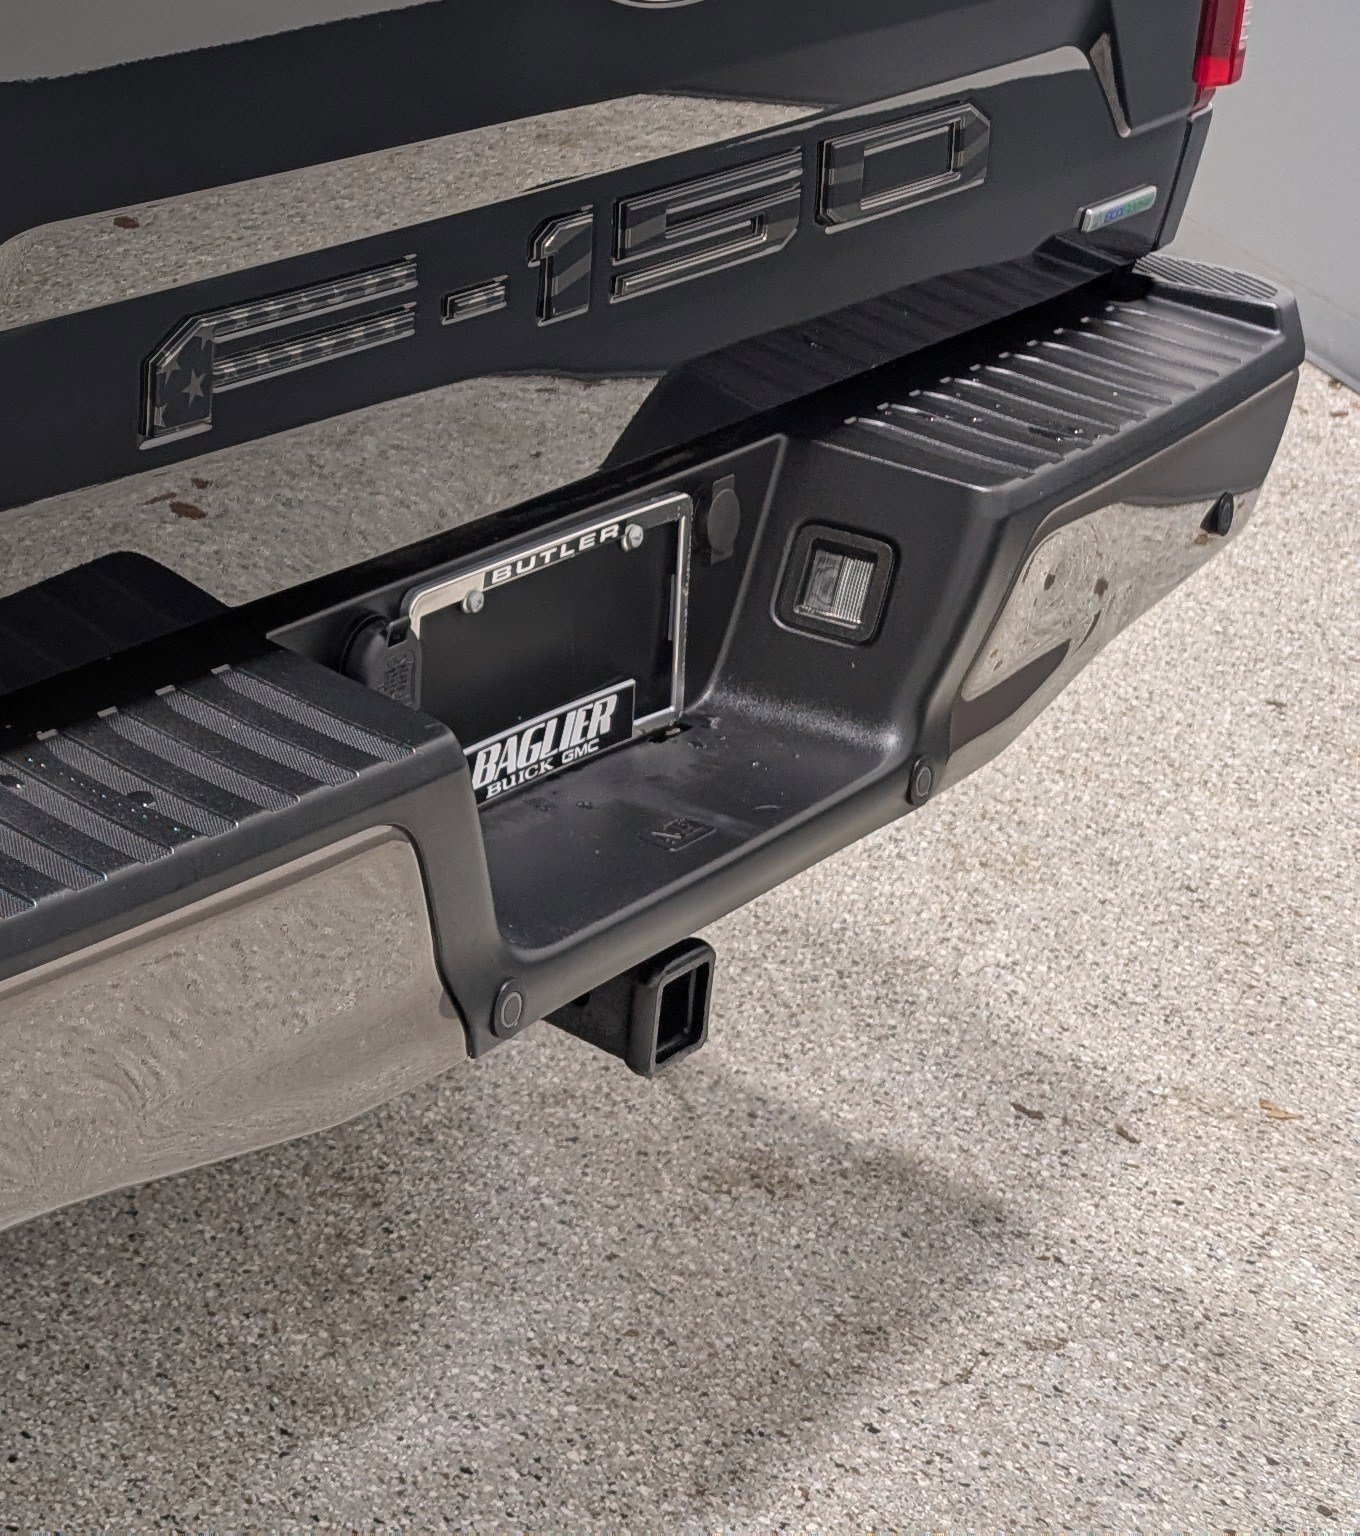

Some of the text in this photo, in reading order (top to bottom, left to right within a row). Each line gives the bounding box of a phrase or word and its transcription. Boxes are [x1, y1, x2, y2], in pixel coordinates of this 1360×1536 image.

[137, 99, 992, 450] F-150
[490, 523, 621, 585] BUTLER
[471, 693, 618, 791] BAGLIER
[485, 737, 600, 800] BUICK GMC
